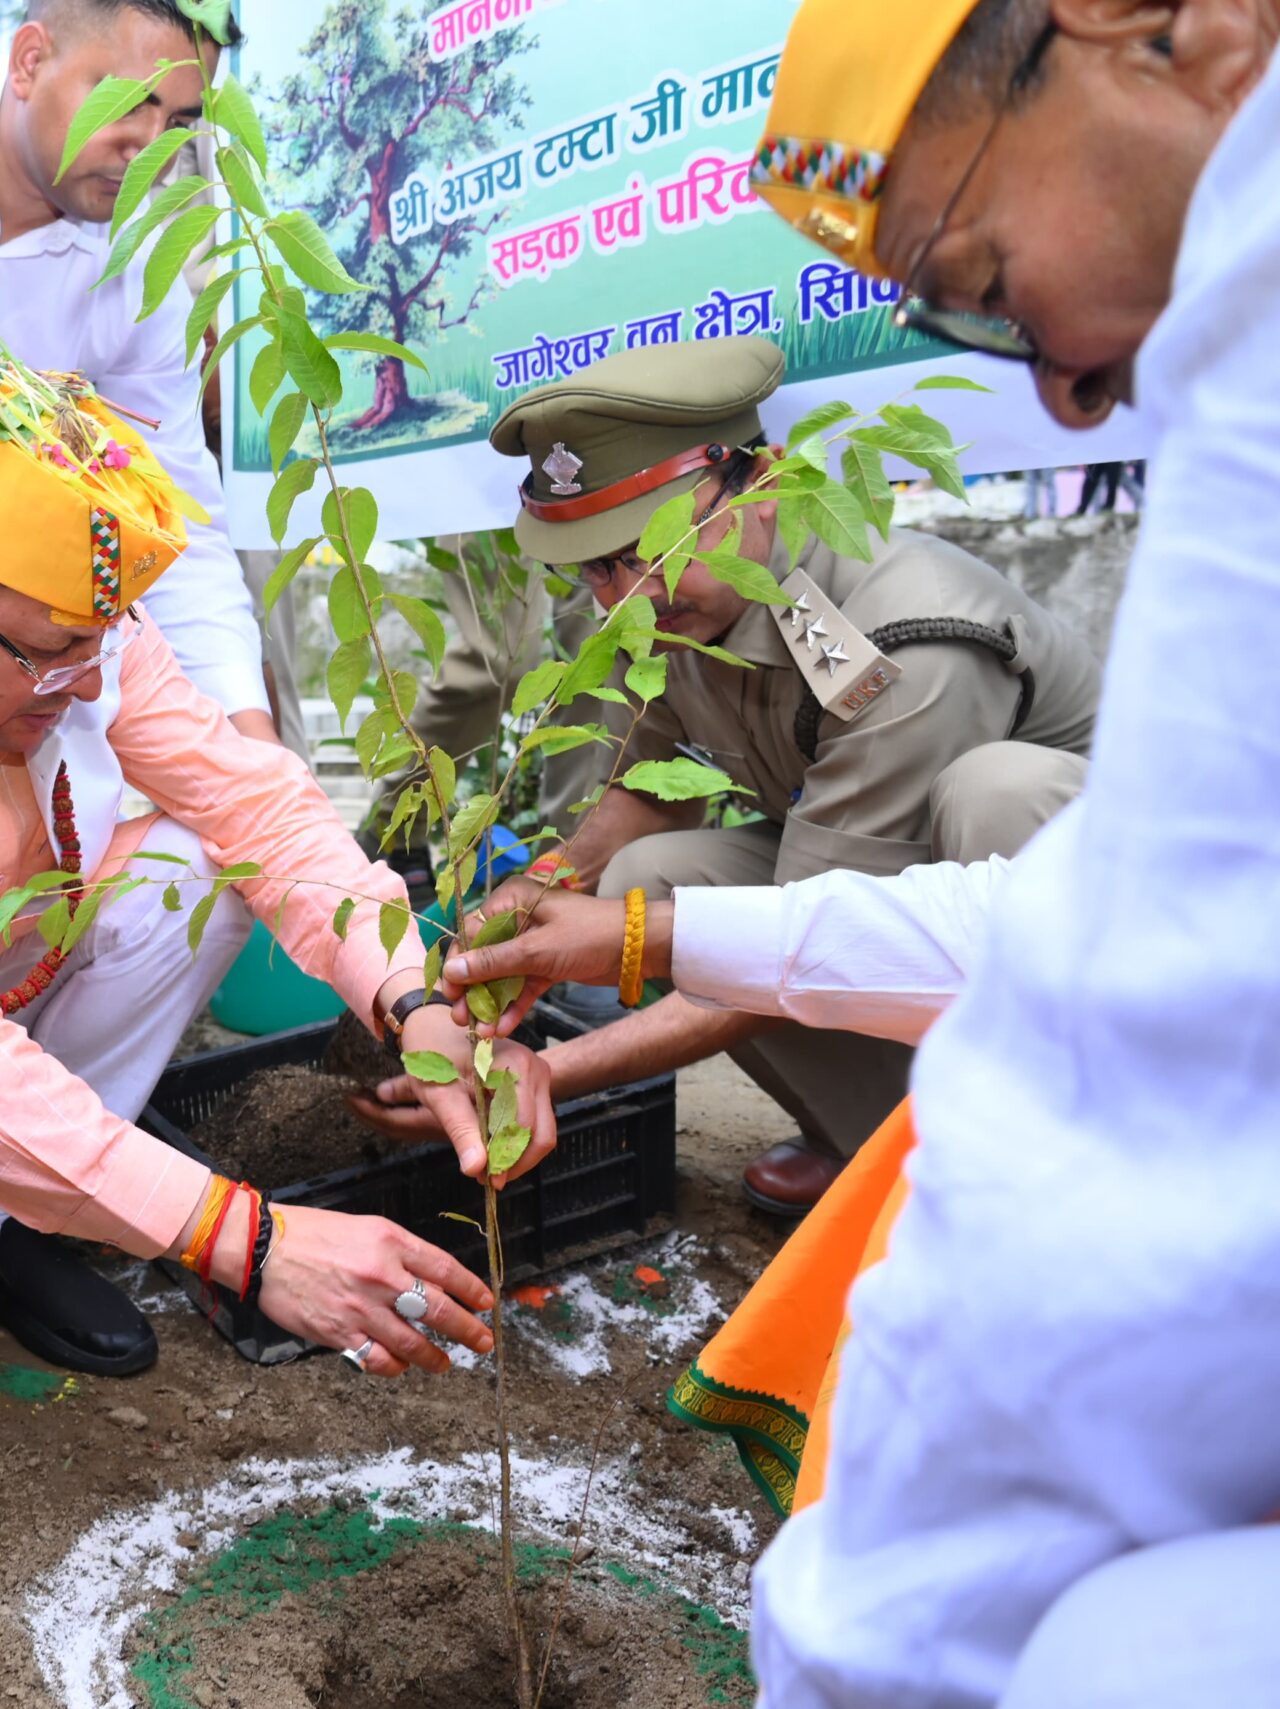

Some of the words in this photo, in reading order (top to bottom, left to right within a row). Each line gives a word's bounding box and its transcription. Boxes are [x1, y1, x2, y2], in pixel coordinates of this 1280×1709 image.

[394, 180, 429, 236] श्री
[440, 150, 523, 215] अजय
[534, 112, 618, 179] टम्टा
[630, 78, 687, 144] जी
[491, 215, 581, 280] सड़क
[593, 180, 644, 246] एवं
[493, 328, 616, 388] जागेश्वर
